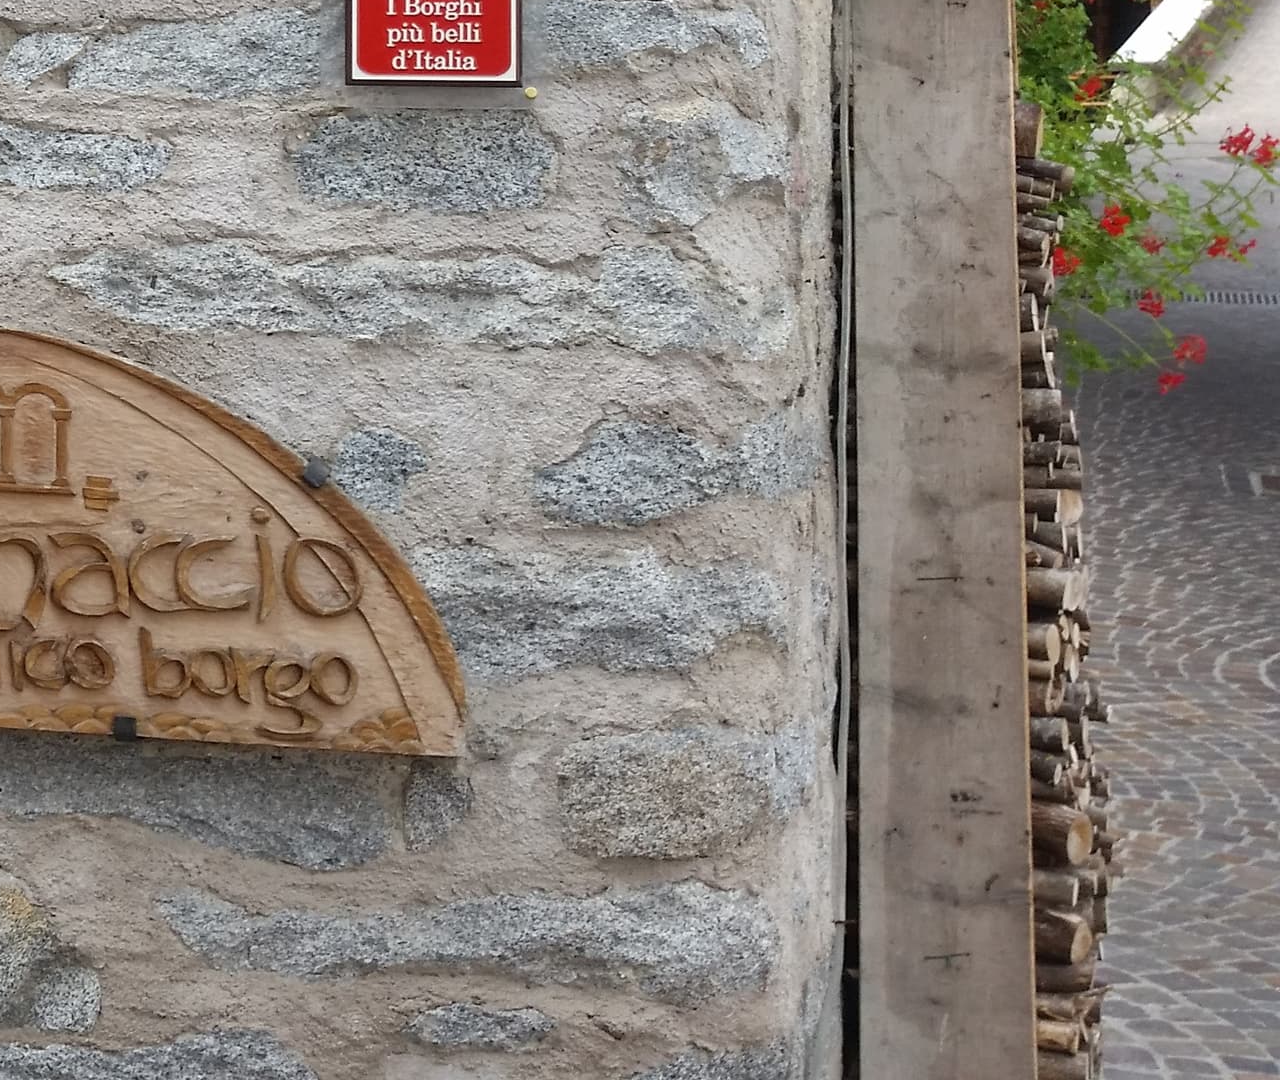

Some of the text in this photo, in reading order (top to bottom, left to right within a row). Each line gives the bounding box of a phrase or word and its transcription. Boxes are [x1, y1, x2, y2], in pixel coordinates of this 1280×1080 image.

[386, 22, 482, 47] più belli
[391, 50, 477, 71] d'Italia
[138, 626, 360, 740] borgo
